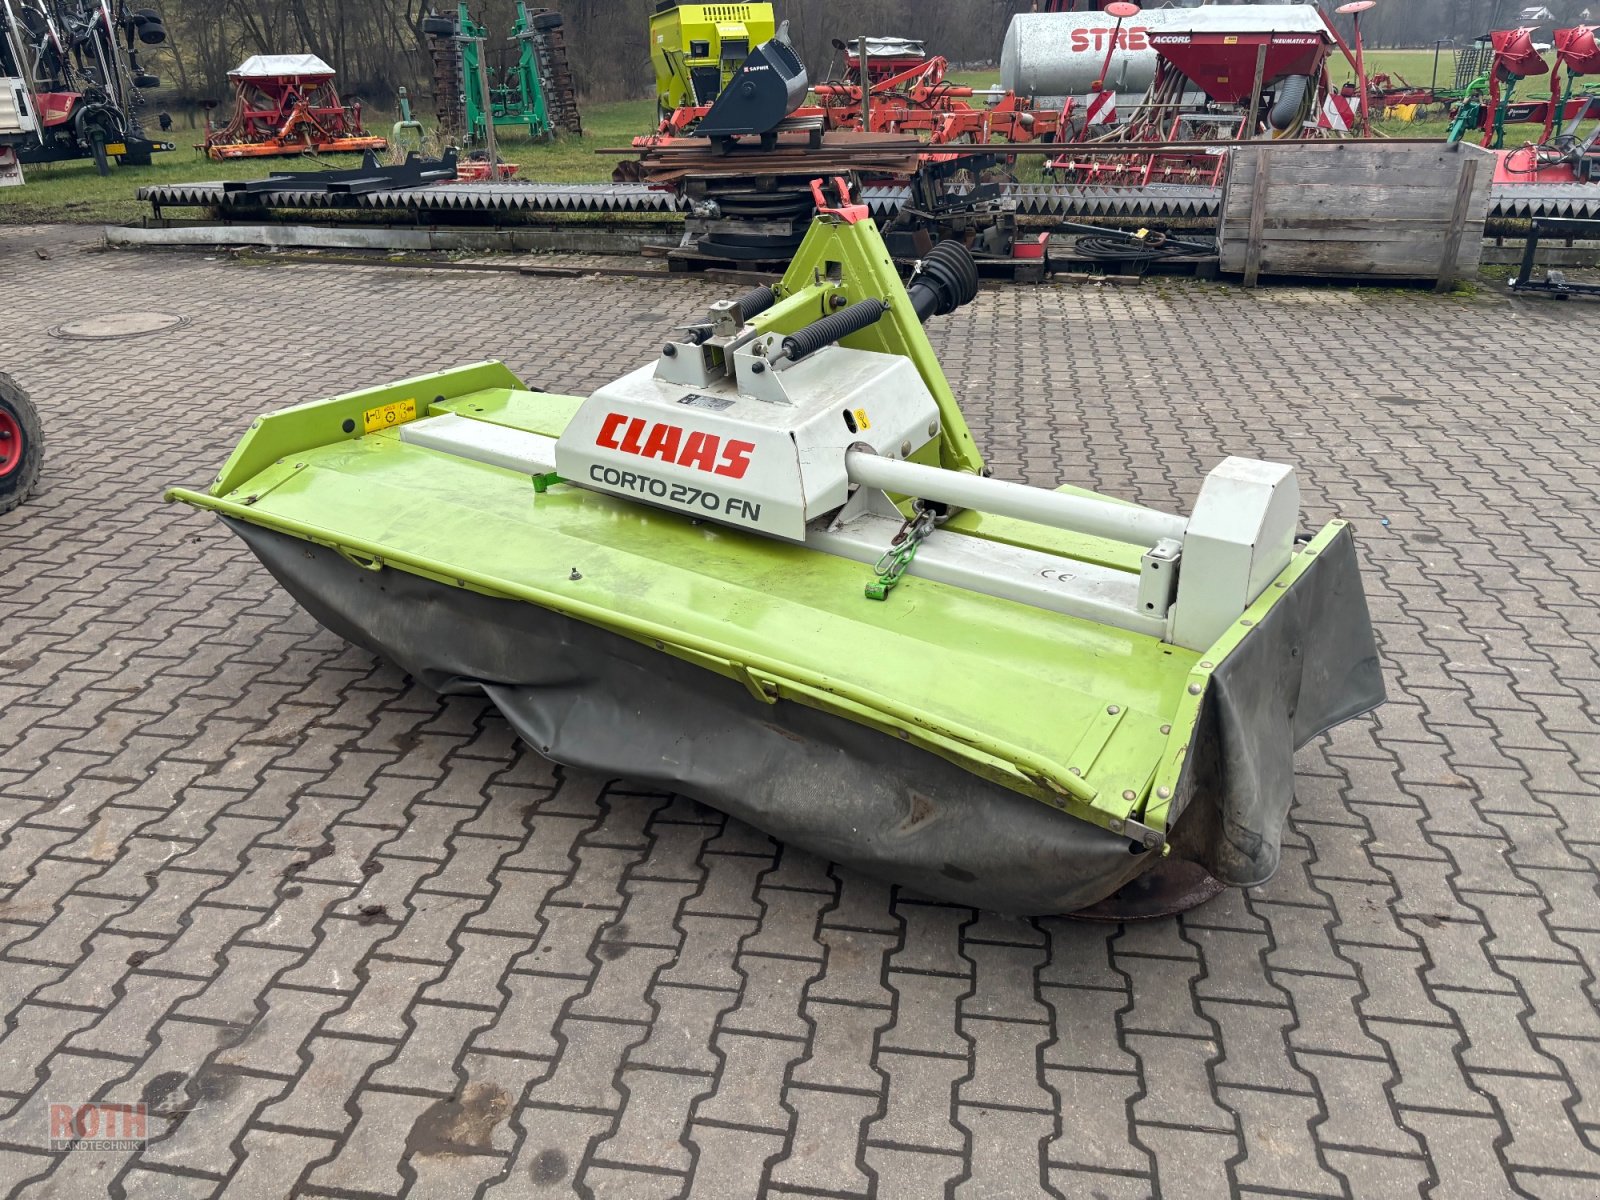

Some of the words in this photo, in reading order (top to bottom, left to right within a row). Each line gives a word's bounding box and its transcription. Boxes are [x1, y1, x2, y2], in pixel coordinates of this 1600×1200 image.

[1071, 26, 1149, 52] STRE
[596, 413, 755, 479] CLAAS
[590, 464, 666, 496] CORTO
[669, 483, 719, 510] 270
[725, 498, 761, 521] FN
[1041, 569, 1073, 582] CE
